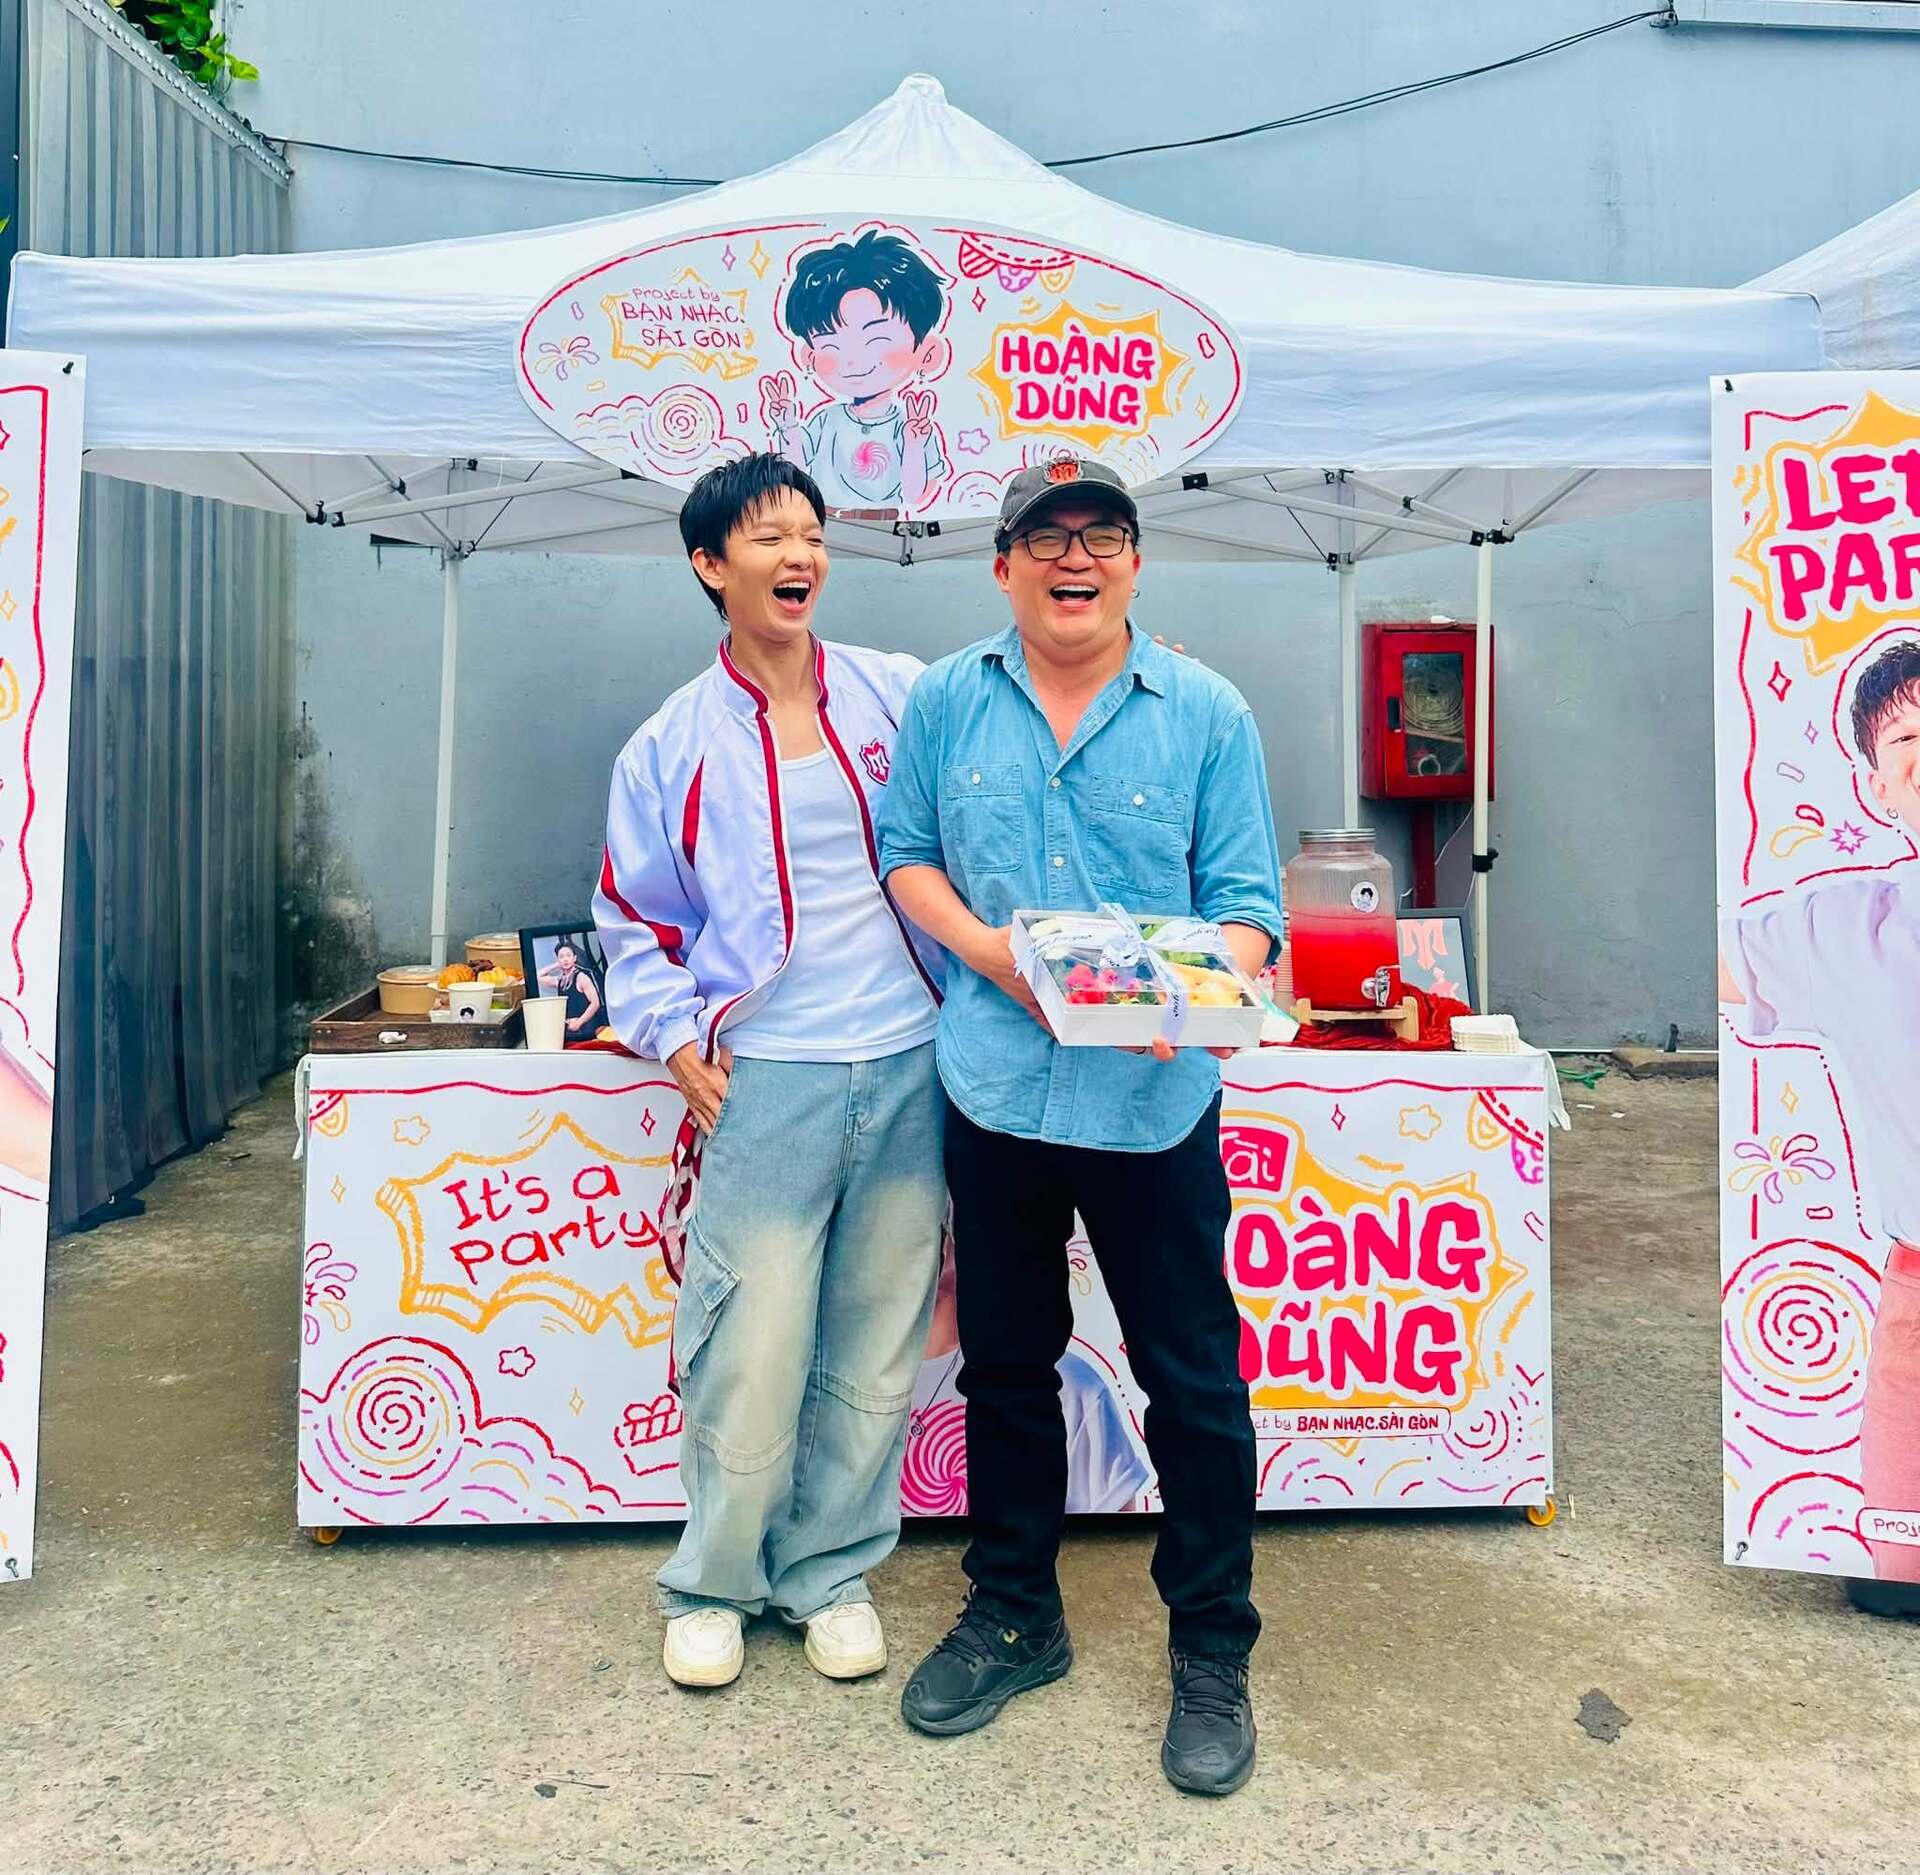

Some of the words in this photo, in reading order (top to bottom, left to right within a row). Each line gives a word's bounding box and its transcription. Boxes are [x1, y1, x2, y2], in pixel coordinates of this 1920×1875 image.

[621, 302, 673, 321] BẠN
[699, 287, 721, 301] by
[641, 323, 687, 347] SÀI
[693, 326, 741, 347] GÒN
[1001, 324, 1155, 380] HOÀNG
[1016, 375, 1141, 425] DŨNG
[442, 1170, 550, 1230] It's
[573, 1164, 621, 1199] a
[450, 1205, 660, 1286] party
[1274, 1415, 1292, 1430] by
[1297, 1415, 1329, 1434] BẠN
[1408, 1413, 1440, 1430] GÒN
